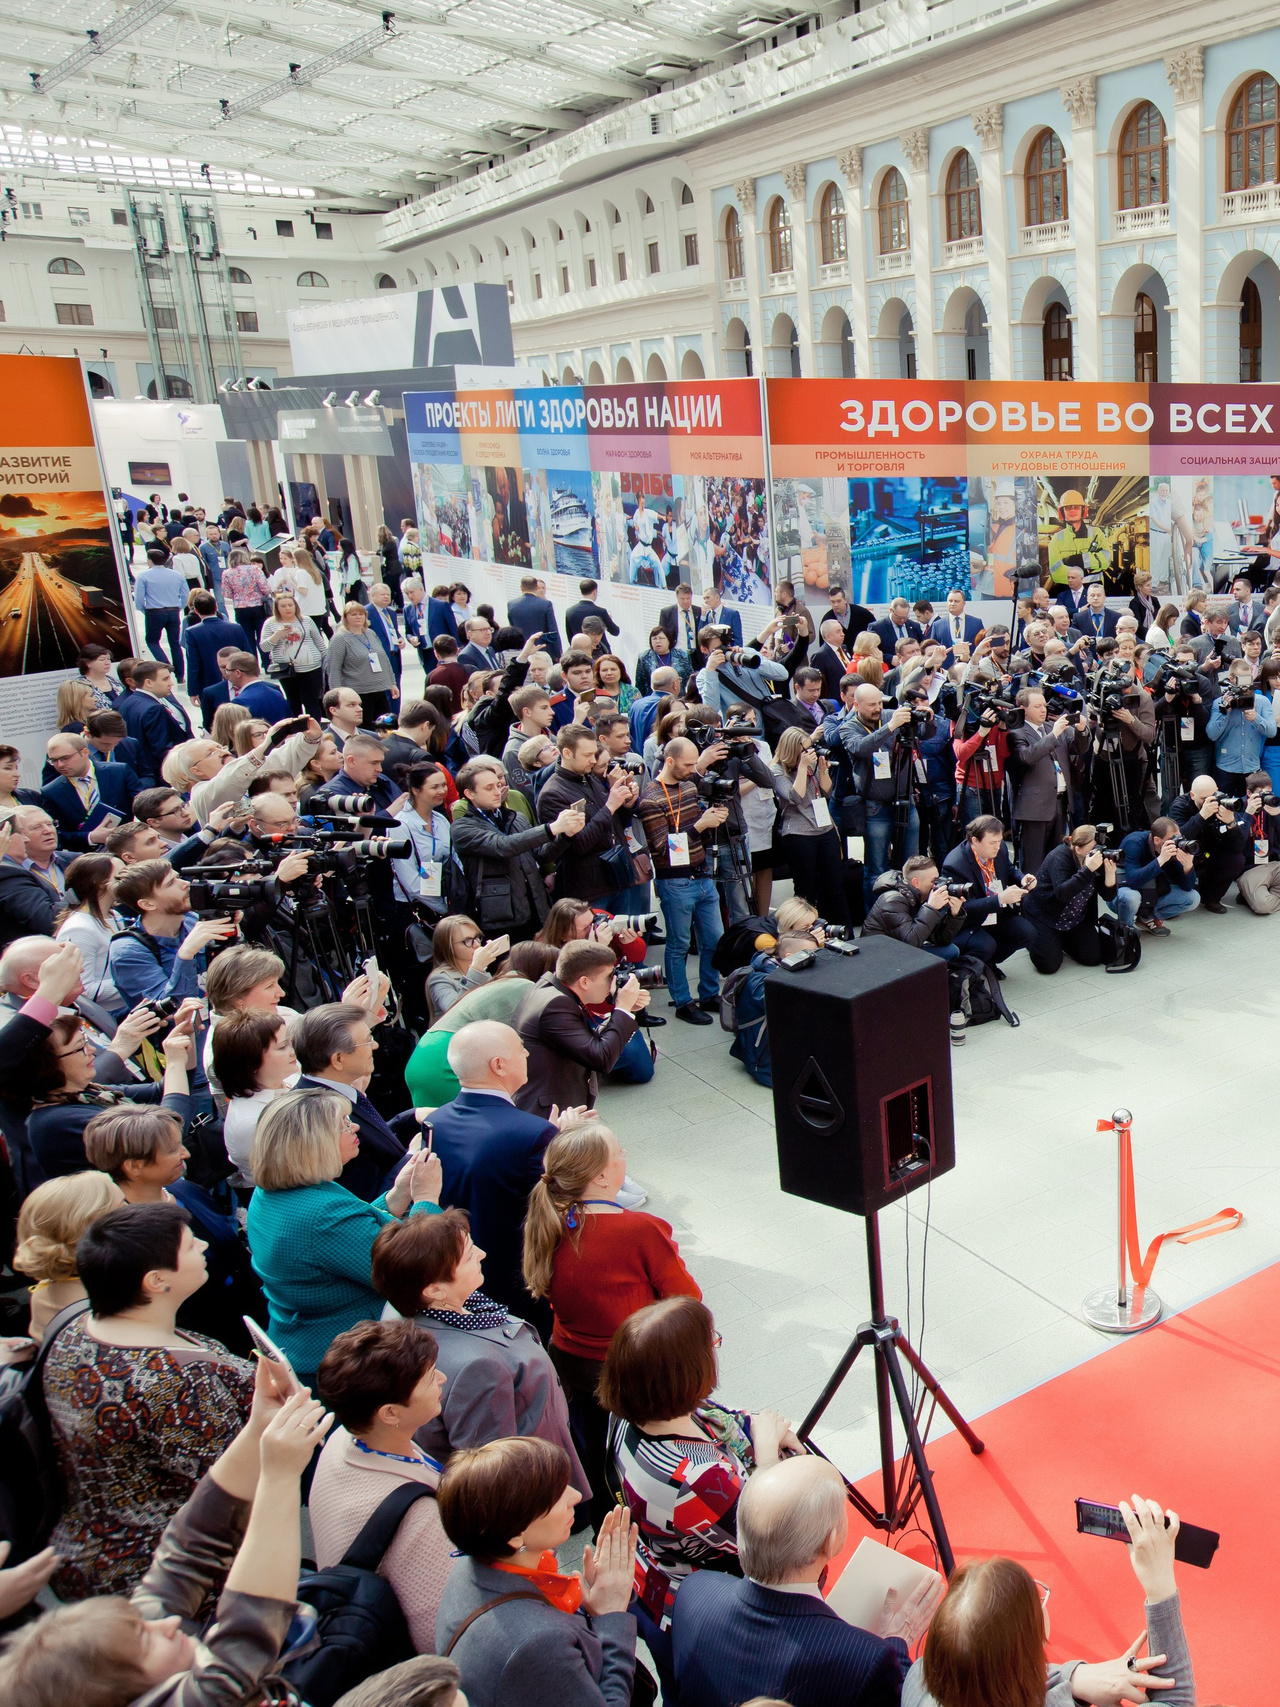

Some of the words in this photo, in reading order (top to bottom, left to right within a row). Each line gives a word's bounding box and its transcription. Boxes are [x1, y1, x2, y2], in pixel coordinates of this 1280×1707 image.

[425, 398, 491, 428] ПРОЕКТЫ
[495, 398, 537, 429] ЛИГИ
[539, 397, 639, 433] ЗДОРОВЬЯ
[644, 394, 722, 433] НАЦИИ
[839, 400, 1082, 437] ЗДОРОВЬЕ
[1097, 402, 1155, 433] ВО
[1169, 403, 1274, 434] ВСЕХ
[536, 448, 549, 456] ВОЛНА
[550, 448, 571, 456] ЗДОРОВЬЯ
[605, 450, 627, 458] МАРАФОН
[628, 450, 652, 459] ЗДОРОВЬЯ
[690, 452, 702, 460] МОЯ
[702, 452, 743, 461] АЛЬТЕРНАТИВА
[815, 451, 926, 461] ПРОМЫШЛЕННОСТЬ
[1020, 450, 1064, 459] ОХРАНА
[1065, 450, 1099, 461] ТРУДА
[1180, 456, 1247, 466] СОЦИАЛЬНАЯ
[837, 463, 845, 471] И
[848, 463, 905, 472] ТОРГОВЛЯ
[992, 462, 999, 471] И
[1001, 462, 1058, 473] ТРУДОВЫЕ
[1060, 462, 1126, 471] ОТНОШЕНИЯ
